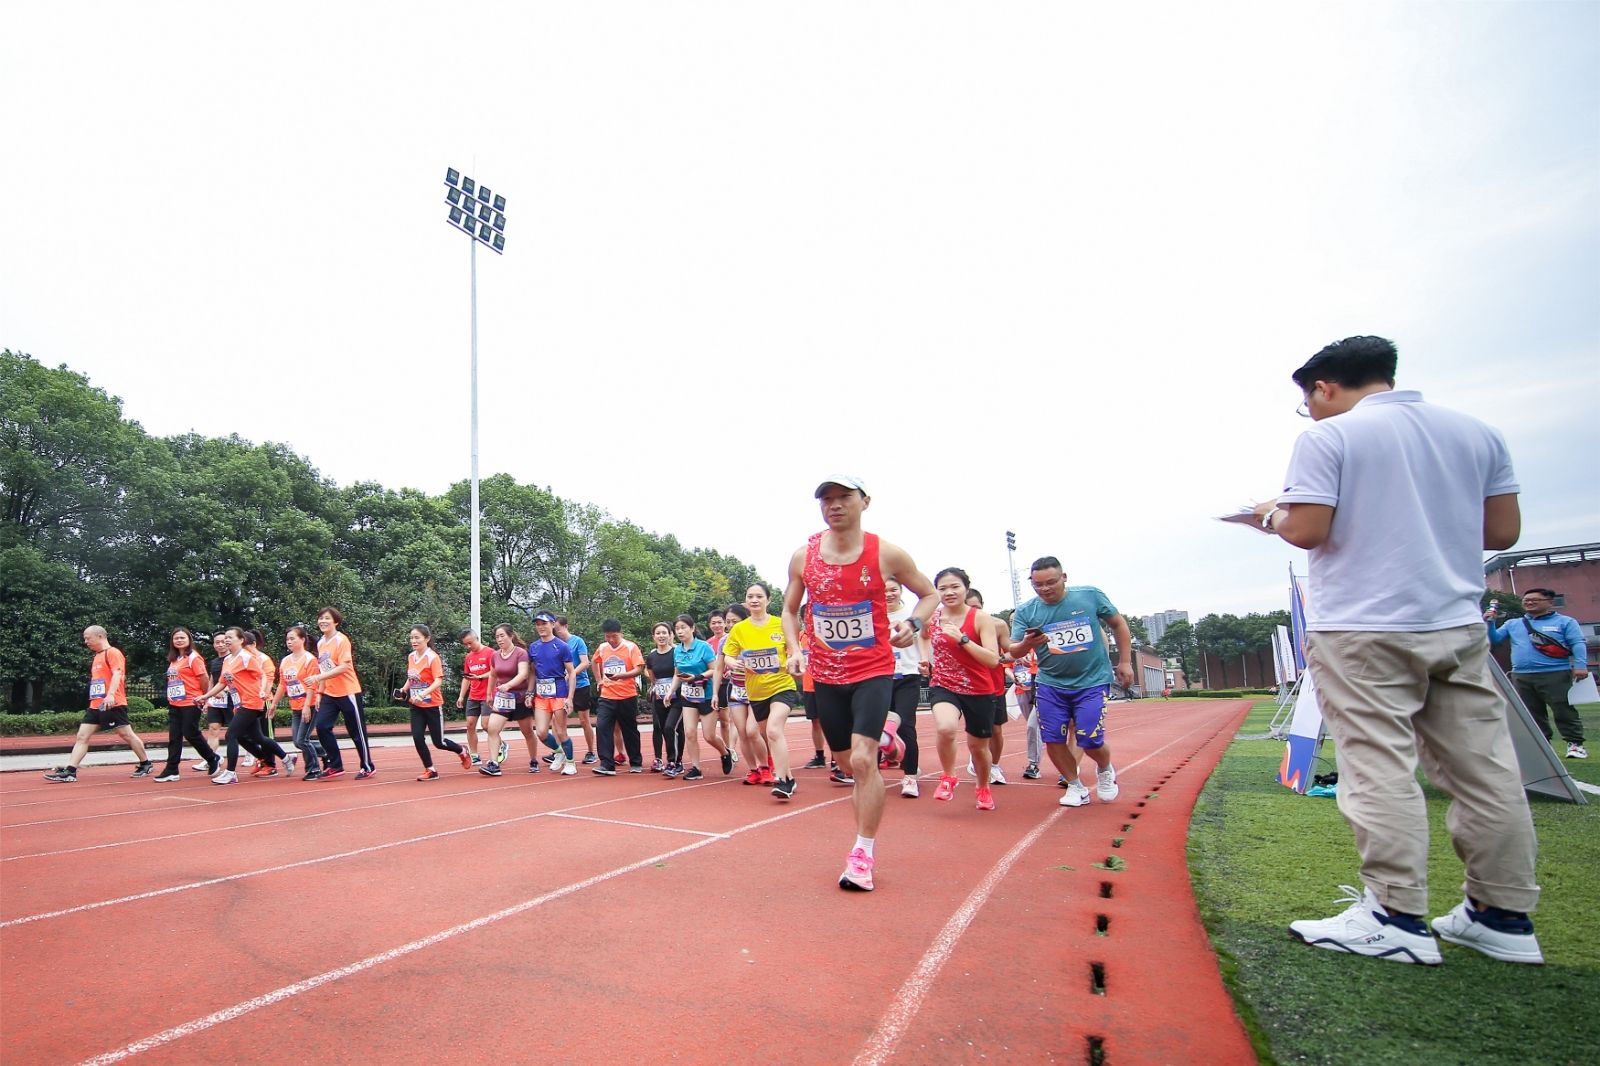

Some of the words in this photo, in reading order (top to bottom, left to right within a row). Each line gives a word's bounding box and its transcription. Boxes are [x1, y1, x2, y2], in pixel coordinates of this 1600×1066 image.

[823, 618, 862, 640] 303
[1055, 628, 1086, 646] 326
[752, 656, 774, 669] 301
[685, 686, 700, 697] 328
[737, 687, 748, 698] 32
